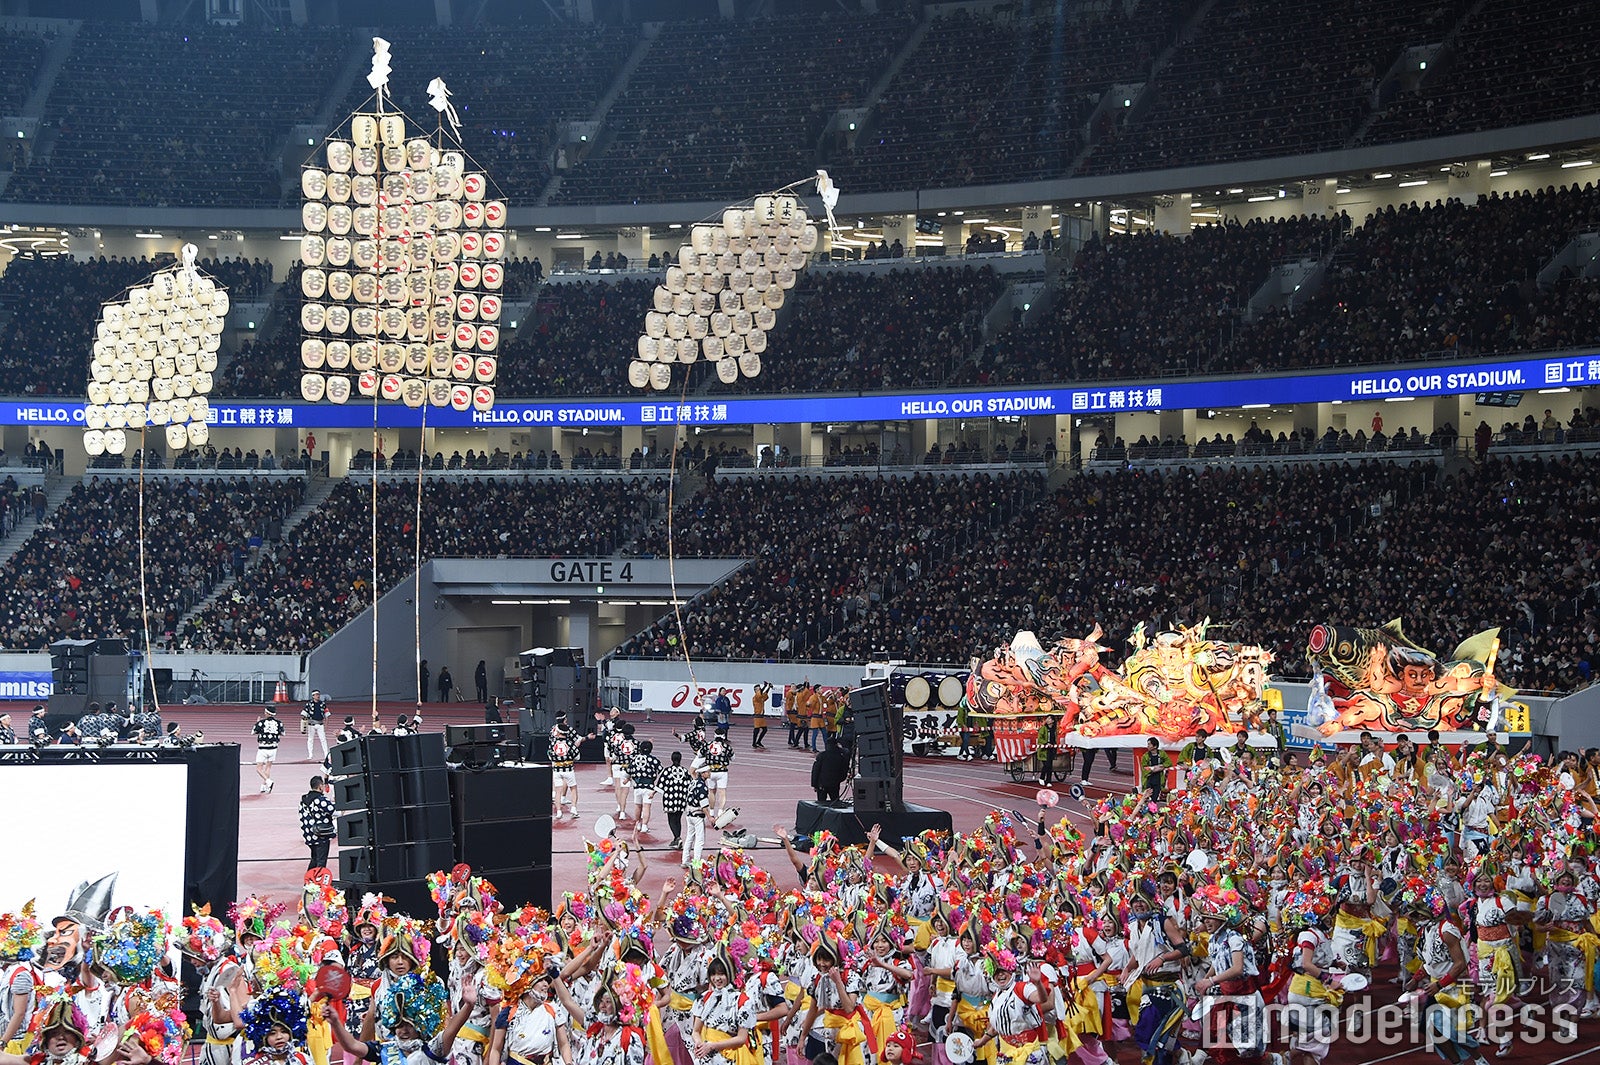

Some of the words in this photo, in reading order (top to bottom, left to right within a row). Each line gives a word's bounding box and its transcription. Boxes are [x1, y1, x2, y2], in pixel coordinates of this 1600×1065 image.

[1352, 379, 1404, 394] HELLO,
[1407, 376, 1441, 392] OUR
[1448, 370, 1526, 389] STADIUM.
[902, 400, 949, 414] HELLO,
[952, 399, 983, 412] OUR
[987, 396, 1055, 412] STADIUM.
[1072, 389, 1162, 410] 国立競技場
[17, 408, 71, 423] HELLO,
[472, 410, 520, 424] HELLO,
[523, 410, 553, 422] OUR
[558, 408, 625, 421] STADIUM.
[641, 405, 727, 421] 国立競技場
[550, 562, 612, 582] GATE
[620, 562, 633, 582] 4
